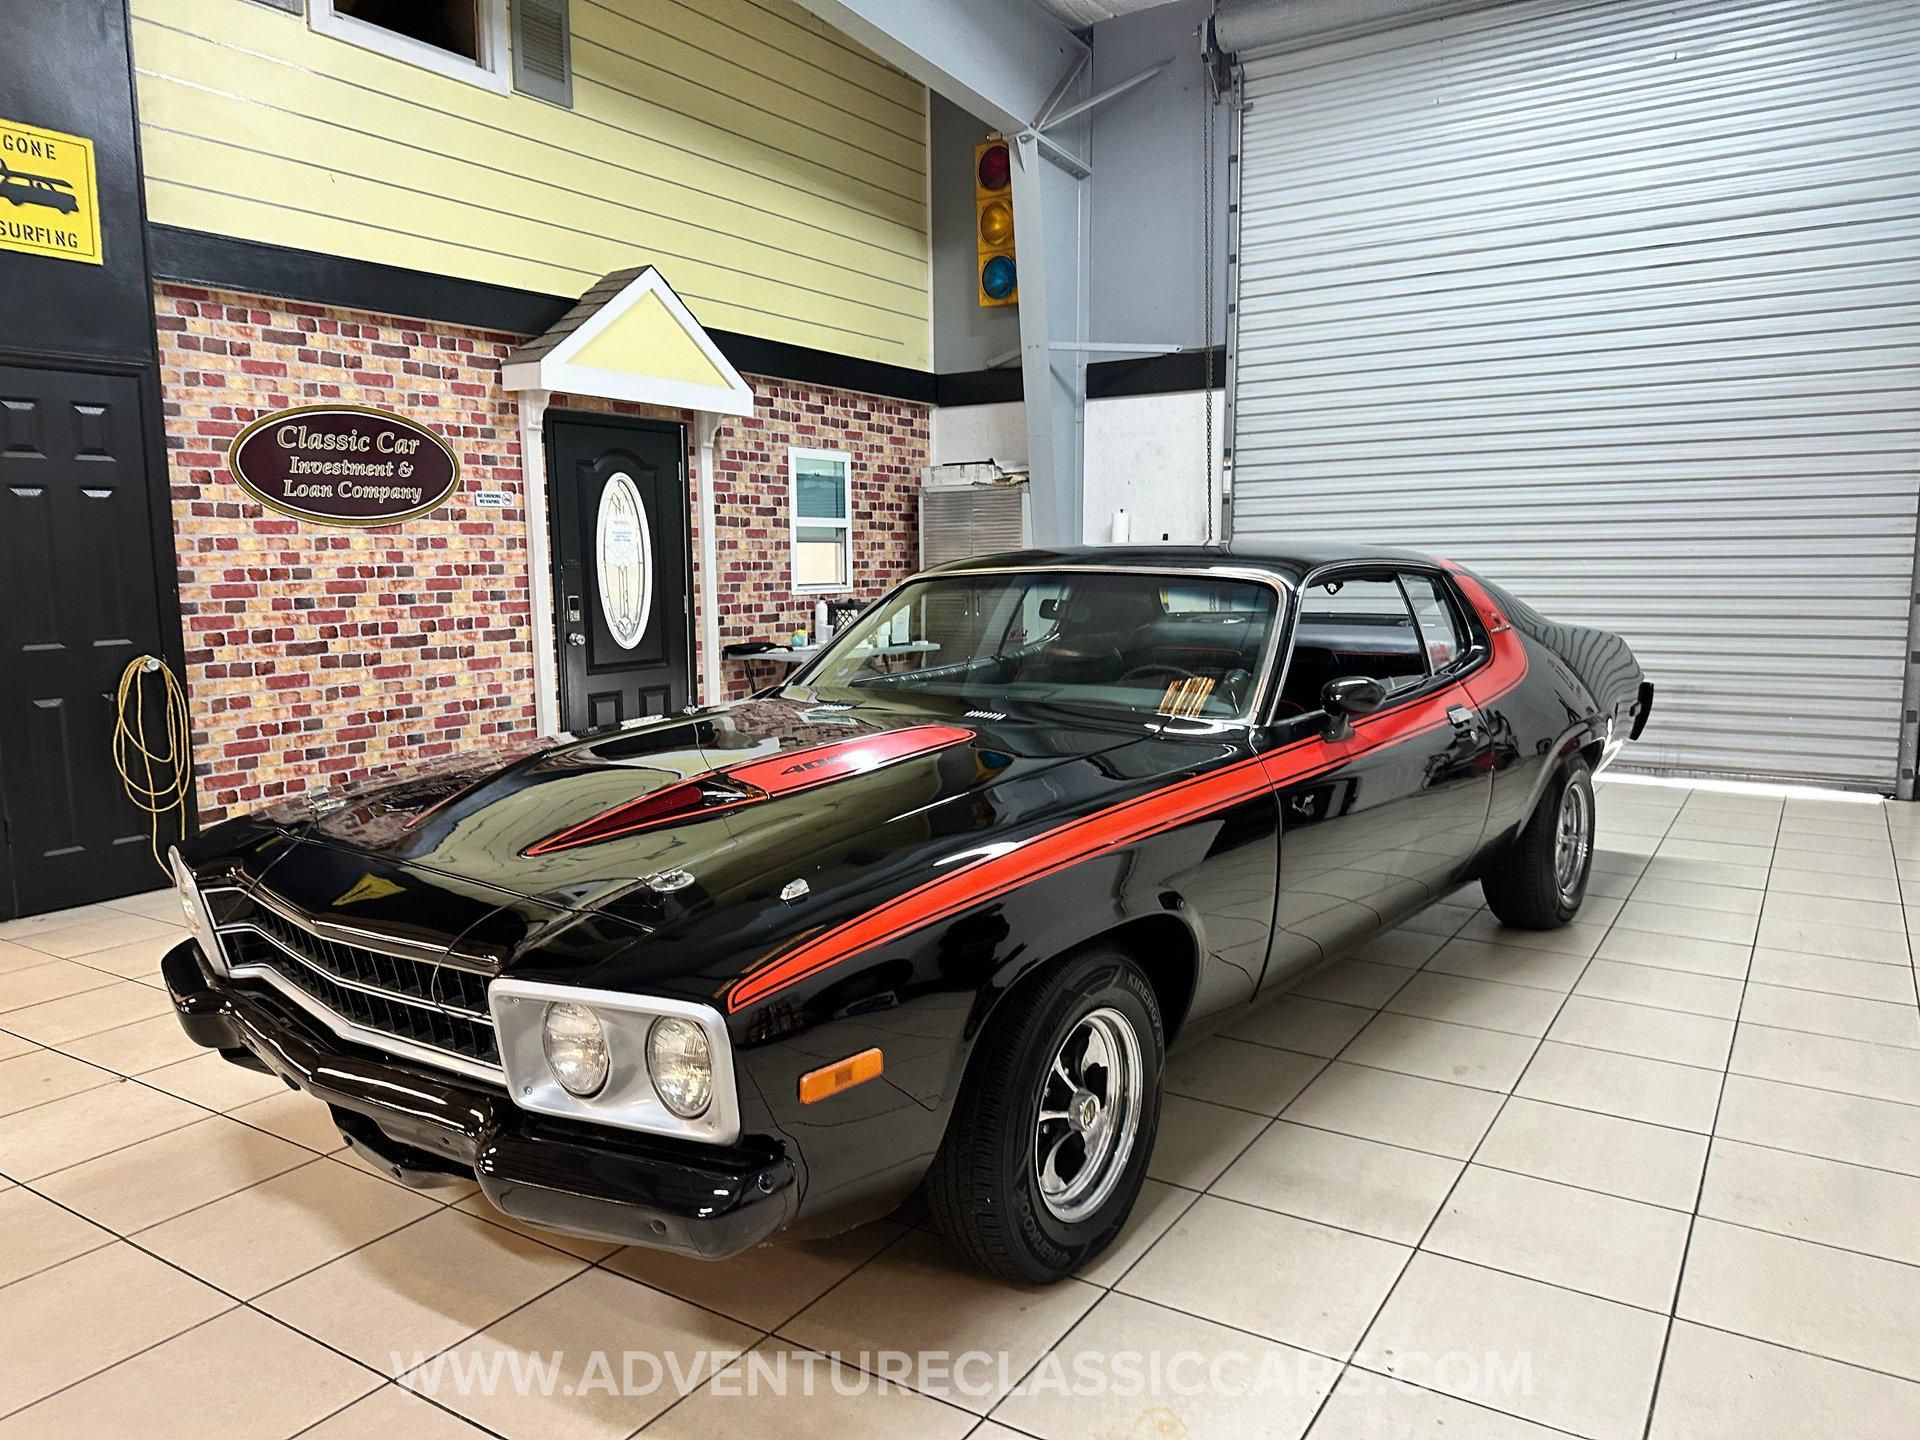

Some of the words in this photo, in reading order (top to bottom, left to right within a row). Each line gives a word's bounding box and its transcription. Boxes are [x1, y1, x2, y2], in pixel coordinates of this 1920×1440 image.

[3, 134, 56, 160] GONE
[277, 425, 370, 452] Classic
[376, 431, 420, 454] Car
[289, 455, 394, 477] Investment
[398, 461, 414, 478] &
[283, 479, 333, 498] Loan
[337, 481, 422, 504] Company
